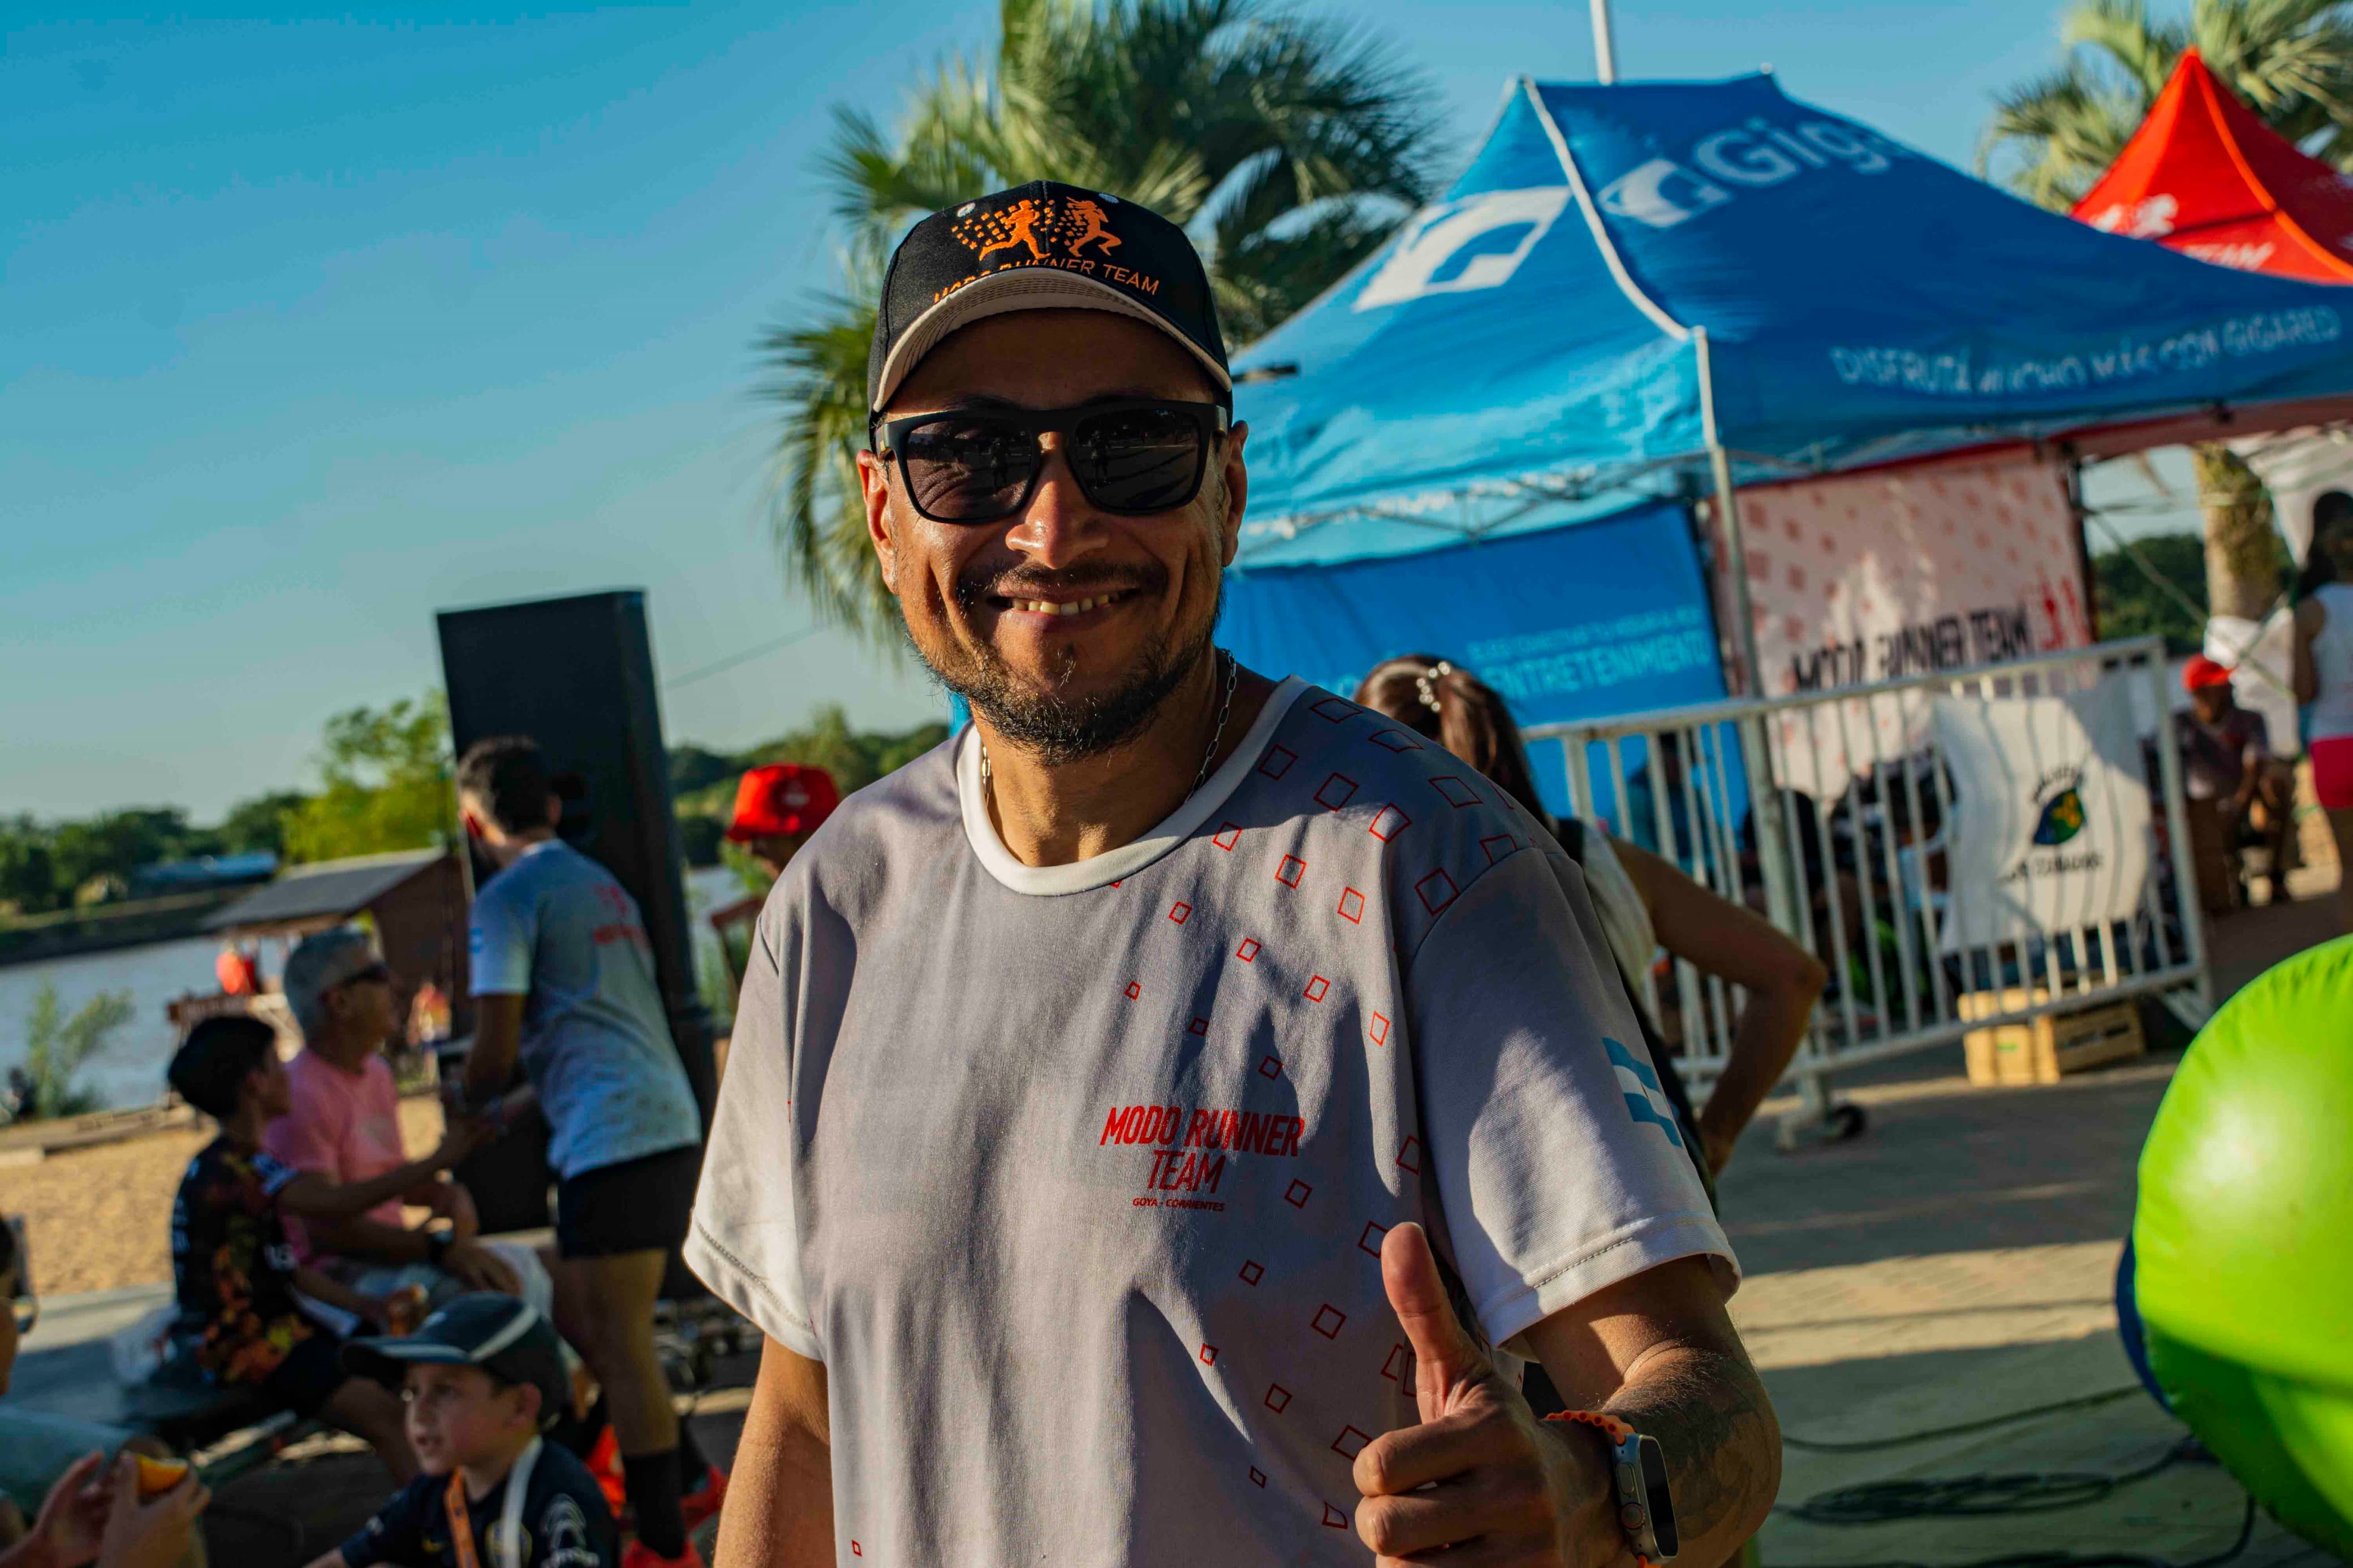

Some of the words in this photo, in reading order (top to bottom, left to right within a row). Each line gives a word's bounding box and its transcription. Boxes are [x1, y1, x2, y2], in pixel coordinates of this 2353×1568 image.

[1695, 118, 1907, 187] Gig
[1103, 264, 1160, 295] TEAM
[1100, 1105, 1182, 1146] MODO
[1184, 1108, 1305, 1157] RUNNER
[1148, 1150, 1227, 1194] TEAM
[1132, 1196, 1158, 1207] GOYA
[1165, 1198, 1226, 1212] CORRIENTES
